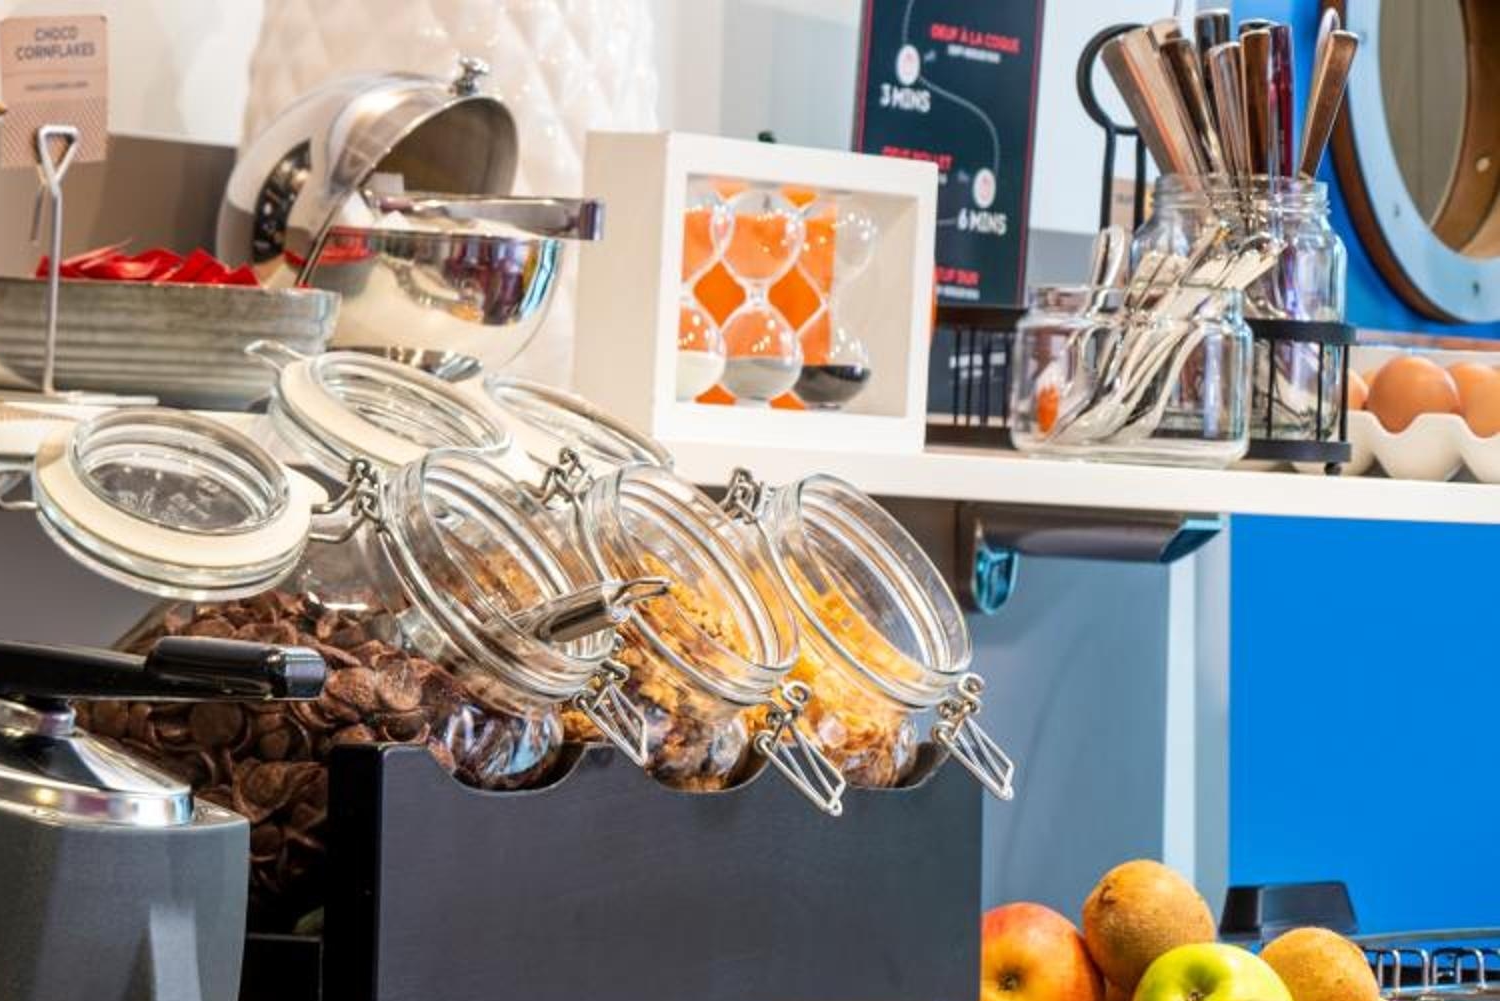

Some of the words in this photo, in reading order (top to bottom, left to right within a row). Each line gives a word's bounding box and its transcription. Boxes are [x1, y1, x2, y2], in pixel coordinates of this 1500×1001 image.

[879, 82, 891, 106] 3
[891, 87, 931, 113] MINS
[957, 207, 969, 230] 6
[969, 210, 1007, 236] MINS
